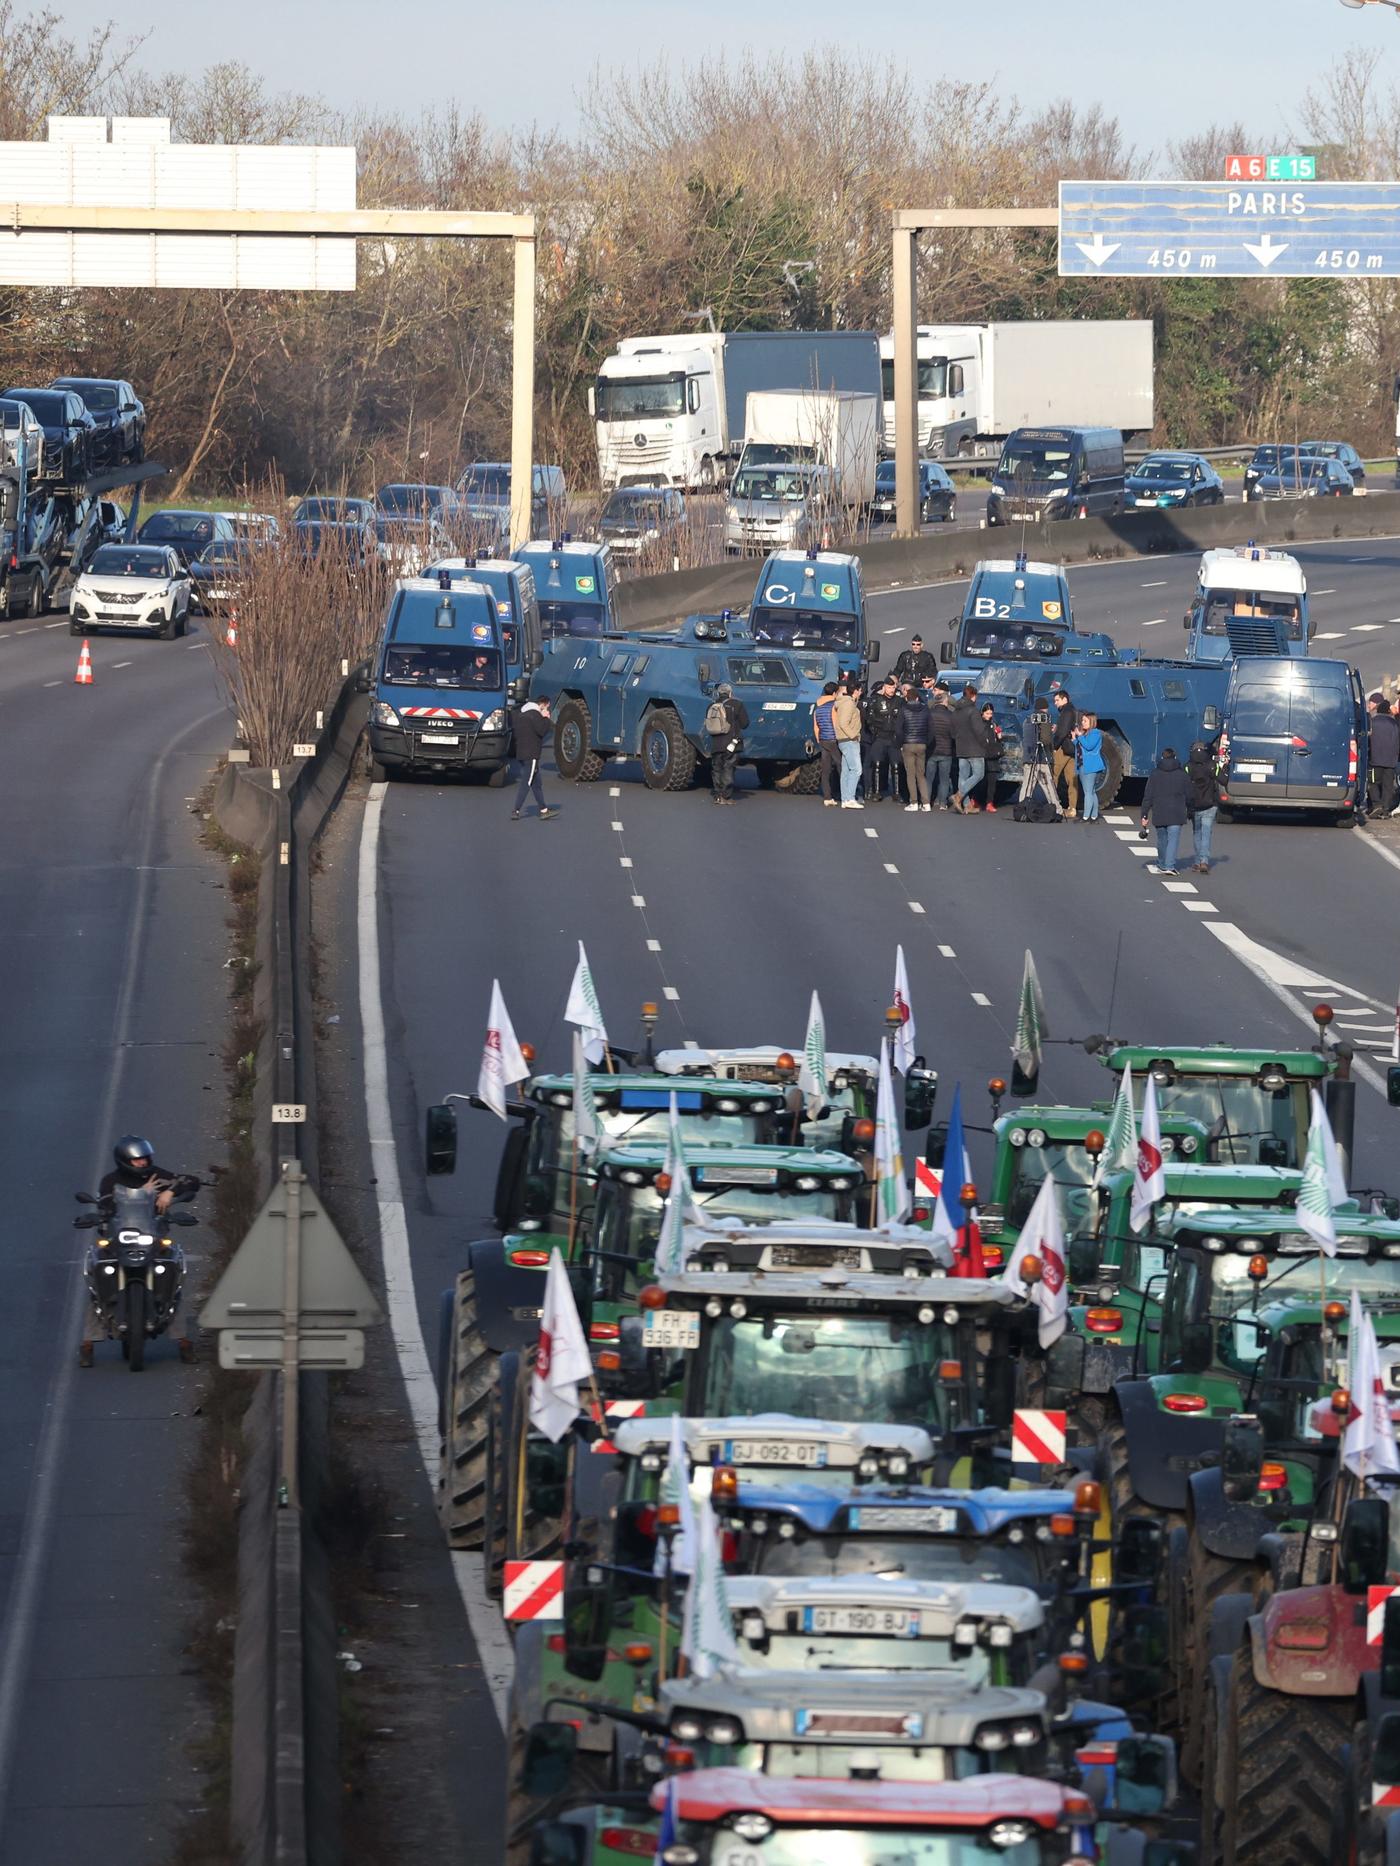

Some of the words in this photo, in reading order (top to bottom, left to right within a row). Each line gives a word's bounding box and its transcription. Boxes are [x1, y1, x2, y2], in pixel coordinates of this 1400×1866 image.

[1229, 158, 1242, 176] A
[1249, 158, 1261, 176] 6
[1270, 158, 1281, 176] E
[1289, 158, 1312, 176] 15
[1228, 192, 1306, 214] PARIS
[1147, 250, 1192, 268] 450
[1200, 253, 1217, 268] m
[1314, 250, 1360, 268] 450
[1366, 253, 1384, 268] m
[765, 585, 796, 605] C1
[574, 657, 587, 670] 10
[278, 1108, 301, 1118] 13.8
